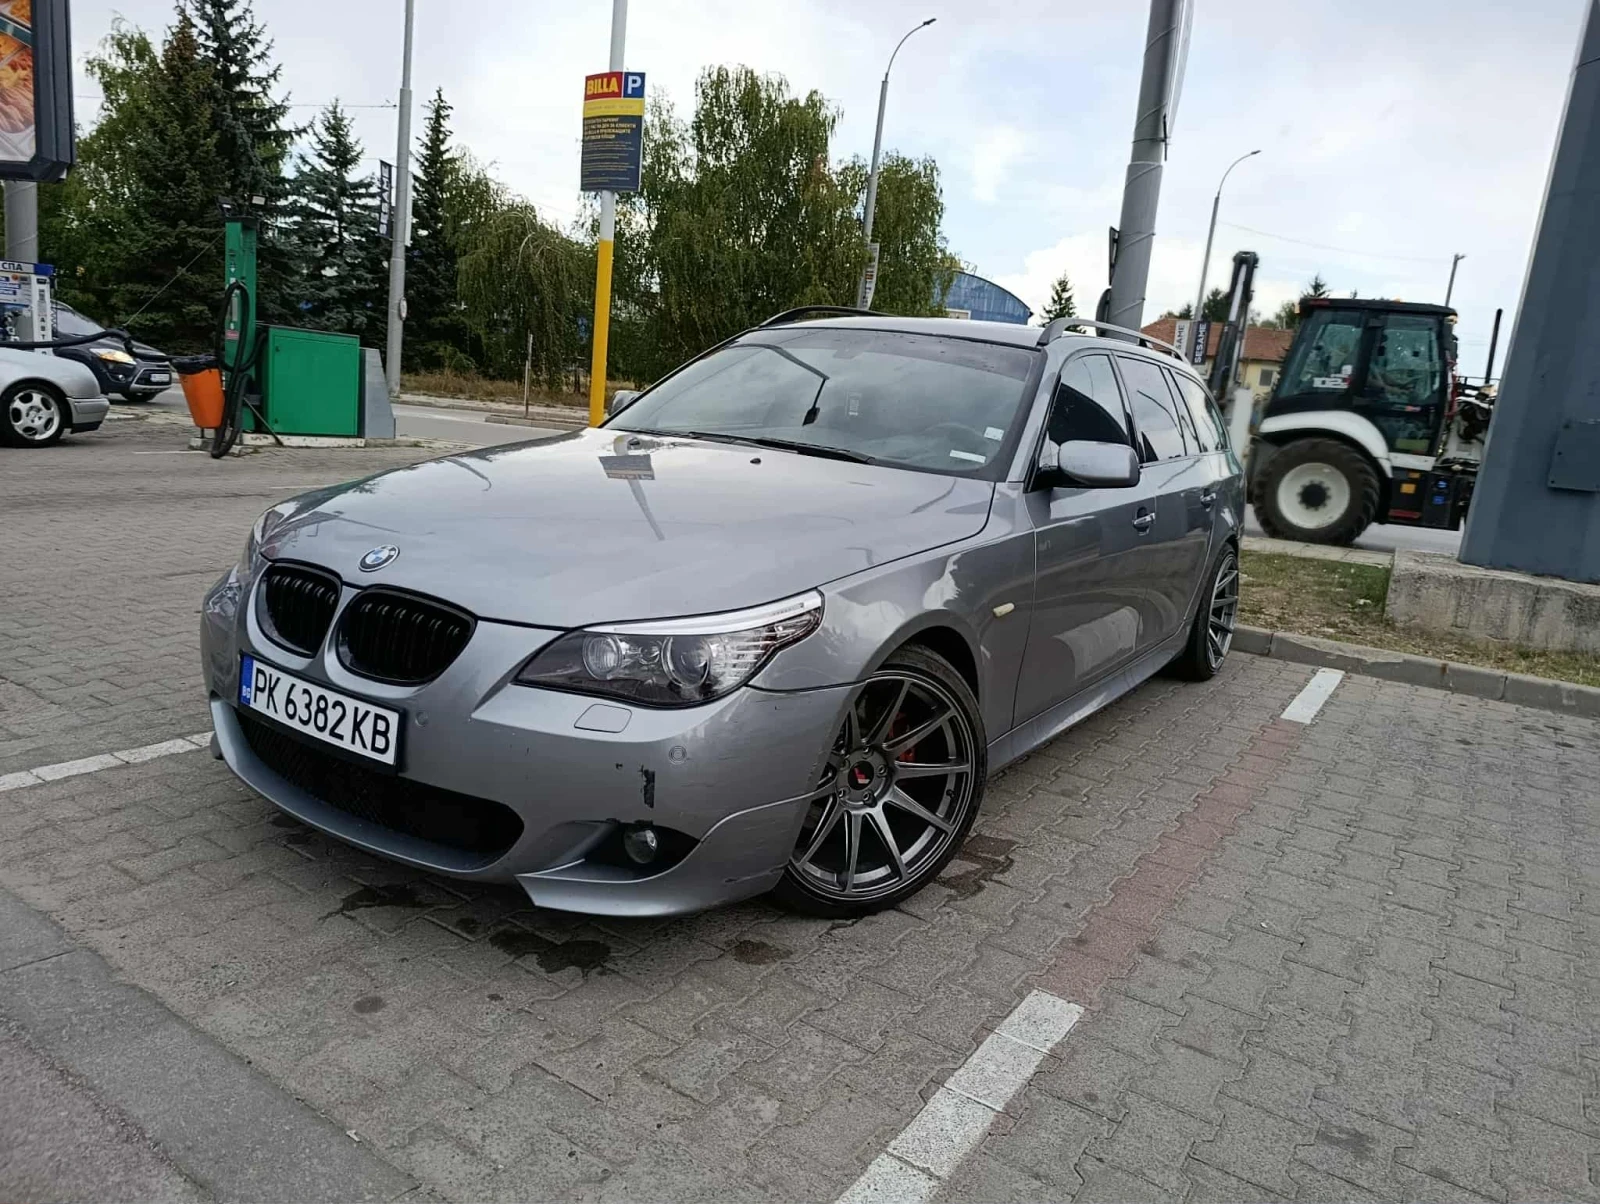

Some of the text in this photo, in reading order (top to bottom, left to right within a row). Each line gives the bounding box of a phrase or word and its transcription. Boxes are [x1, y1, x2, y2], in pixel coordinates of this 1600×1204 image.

[587, 77, 618, 95] BILLA
[628, 75, 642, 94] P
[1, 262, 23, 271] СПА
[1194, 323, 1207, 363] SESAME
[242, 685, 251, 698] BG
[253, 667, 390, 755] PK 6382 KB
